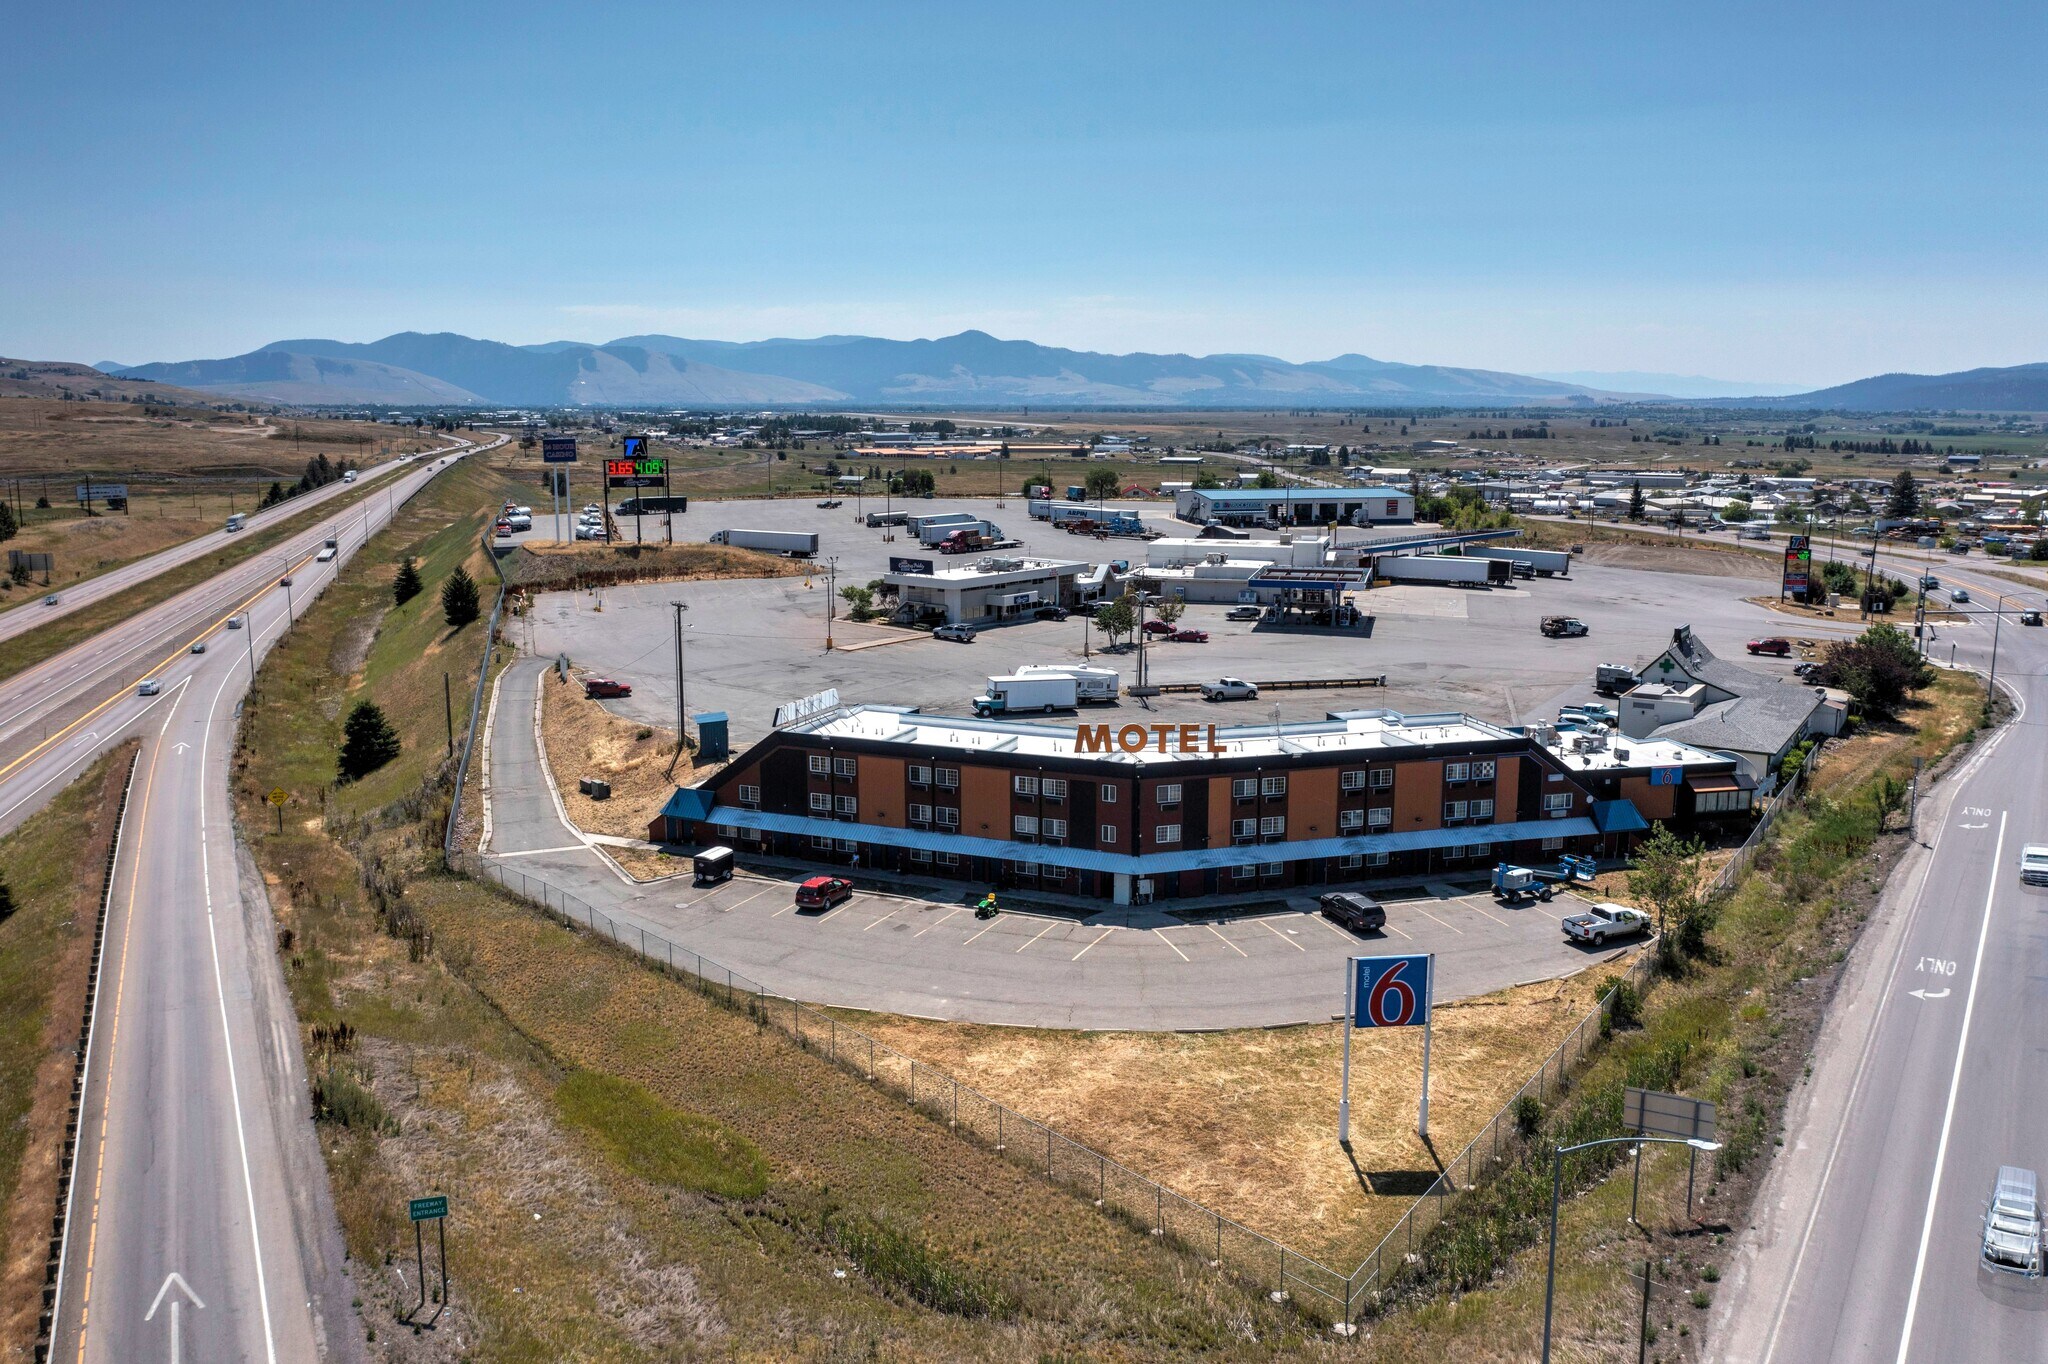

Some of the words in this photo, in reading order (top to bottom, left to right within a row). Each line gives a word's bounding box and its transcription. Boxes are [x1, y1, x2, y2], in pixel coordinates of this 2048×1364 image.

[624, 438, 647, 457] TA
[1791, 536, 1808, 549] TA
[1074, 722, 1228, 754] MOTEL
[1661, 768, 1673, 785] 6
[1961, 806, 1992, 817] ONLY
[1914, 956, 1957, 976] ONLY
[1362, 966, 1371, 989] motel
[1367, 960, 1417, 1027] 6
[412, 1207, 447, 1217] ENTRANCE
[413, 1200, 444, 1210] FREEWAY
